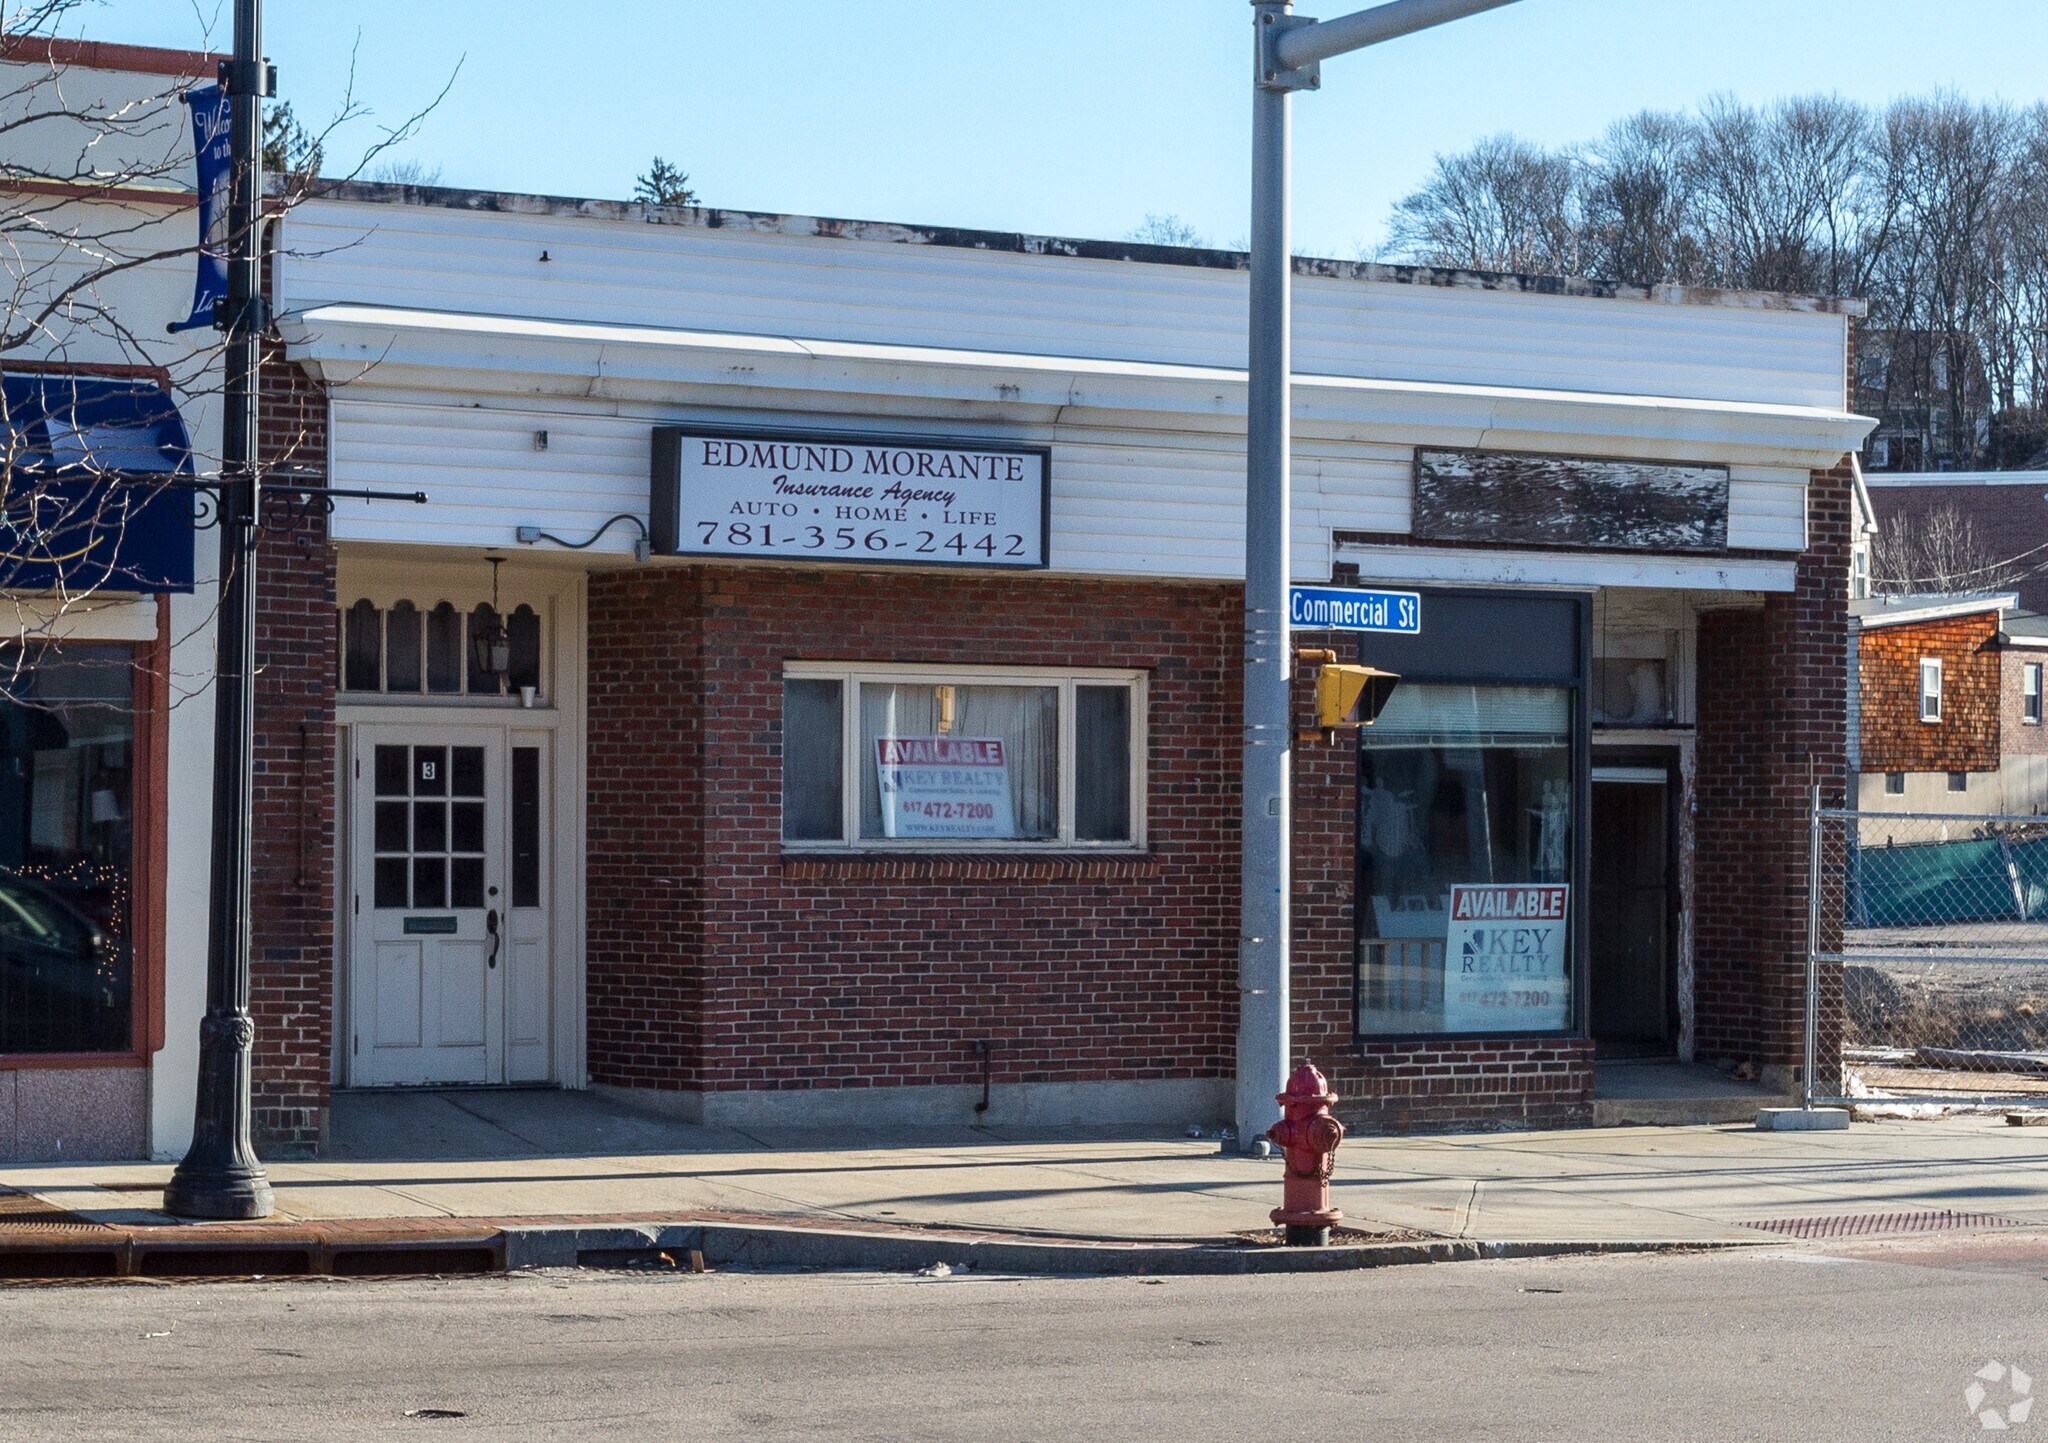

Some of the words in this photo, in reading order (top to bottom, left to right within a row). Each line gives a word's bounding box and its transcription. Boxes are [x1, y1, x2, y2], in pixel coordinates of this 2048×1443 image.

[223, 138, 231, 158] th
[702, 441, 853, 473] EDMUND
[862, 450, 1024, 481] MORANTE
[772, 475, 873, 499] Insurance
[881, 480, 956, 508] Agency
[729, 501, 798, 517] AUTO
[835, 506, 907, 522] HOME
[943, 511, 997, 526] LIFE
[698, 521, 1026, 557] 781-356-2442
[1292, 592, 1389, 626] Commercial
[1399, 598, 1415, 628] St
[885, 740, 1000, 763] AVAILABLE
[425, 763, 434, 778] 3
[904, 771, 937, 786] KEY
[941, 771, 1004, 787] REALTY
[1456, 890, 1563, 918] AVAILABLE
[1490, 929, 1552, 955] KEY
[1461, 955, 1550, 973] REALTY
